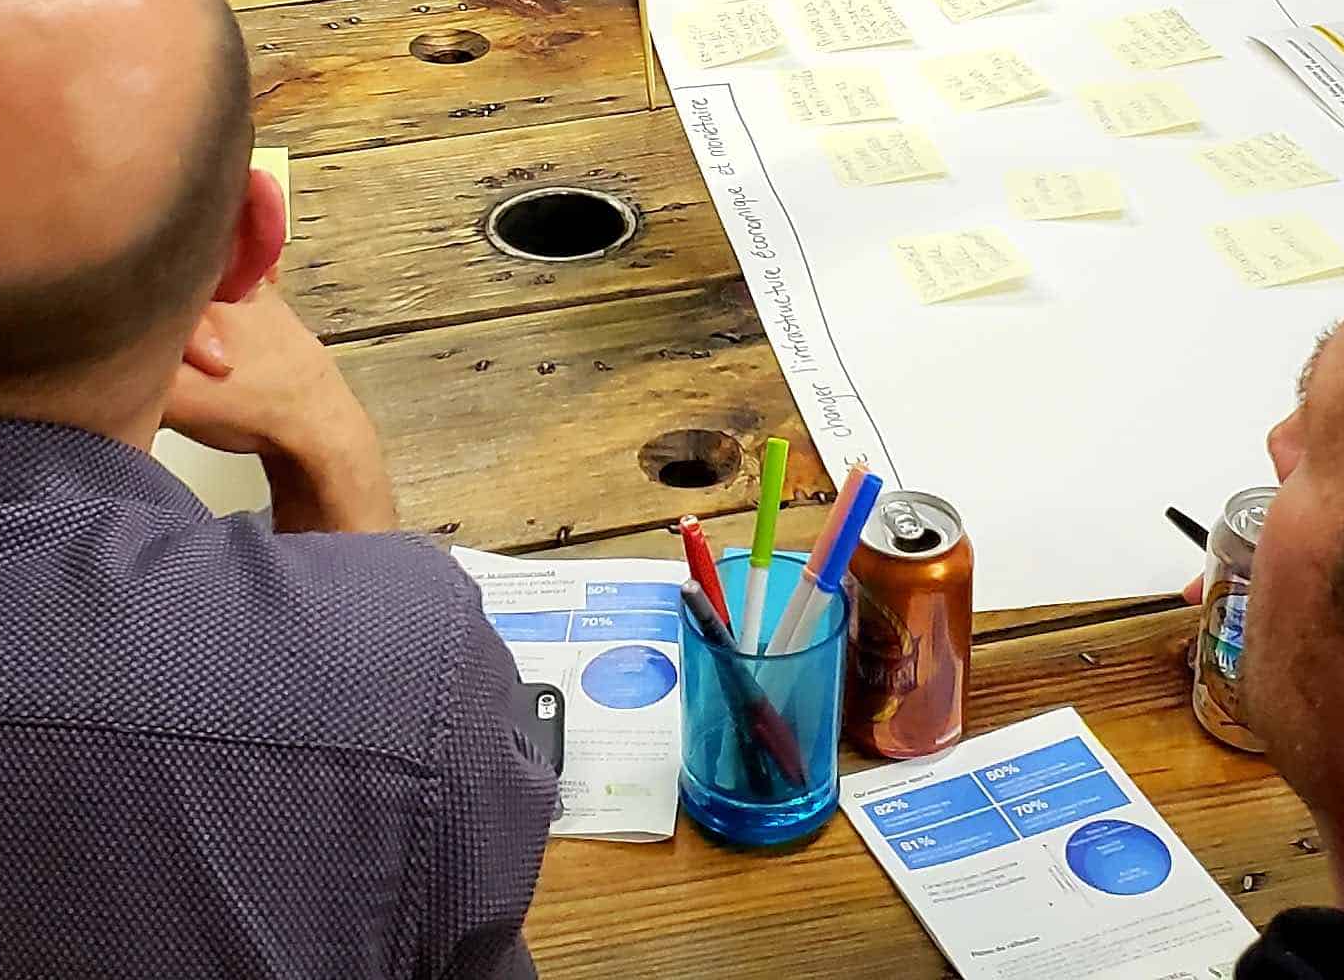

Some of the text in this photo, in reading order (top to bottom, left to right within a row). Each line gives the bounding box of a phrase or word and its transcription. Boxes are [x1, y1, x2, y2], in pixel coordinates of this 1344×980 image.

[709, 162, 735, 177] et
[580, 617, 614, 628] 70%
[1012, 799, 1049, 817] 70%
